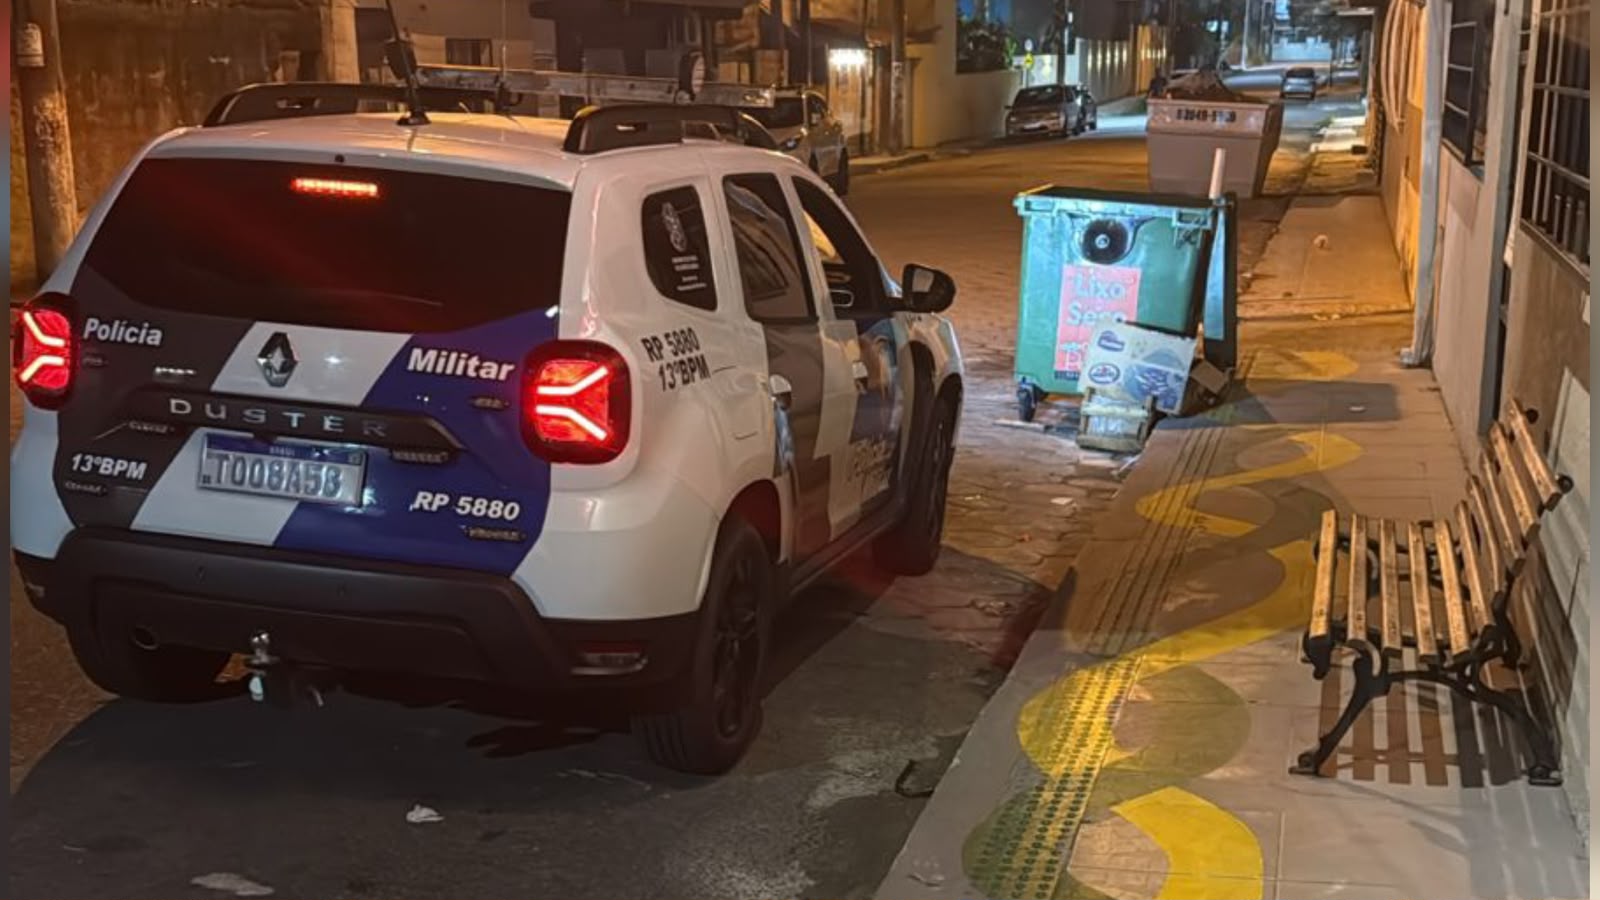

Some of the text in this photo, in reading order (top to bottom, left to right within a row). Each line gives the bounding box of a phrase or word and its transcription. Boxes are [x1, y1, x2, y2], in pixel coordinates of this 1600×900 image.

[1073, 270, 1126, 299] Lixo
[83, 317, 163, 346] Polícia
[641, 327, 700, 363] RP 5880
[407, 347, 515, 381] Militar
[169, 398, 388, 437] DUSTER
[411, 491, 520, 521] RP 5880
